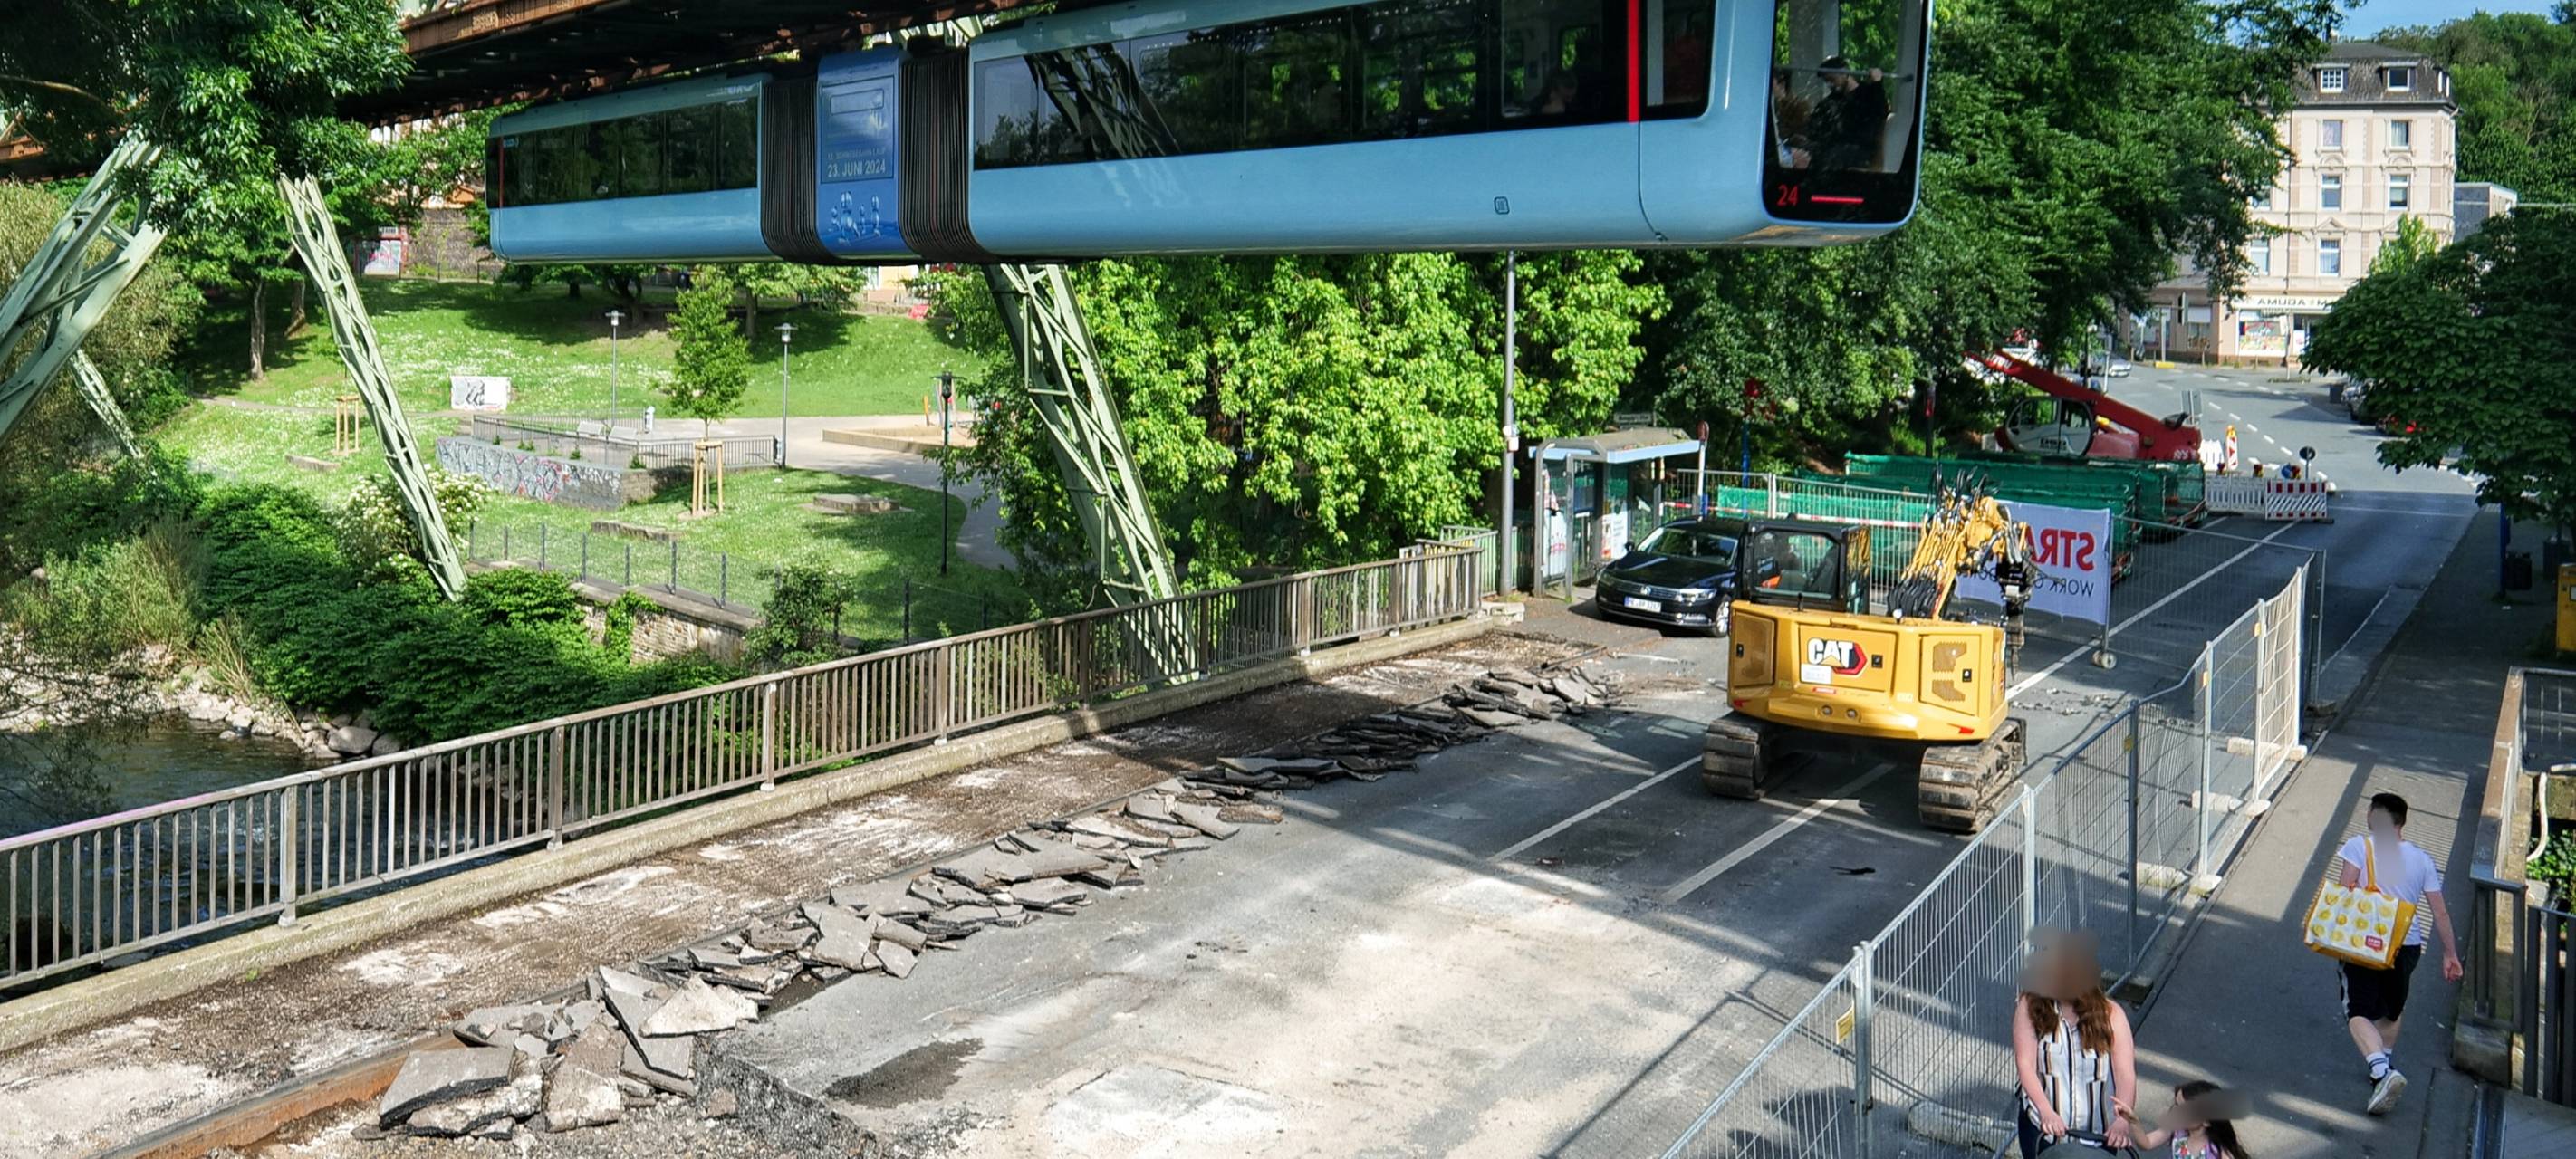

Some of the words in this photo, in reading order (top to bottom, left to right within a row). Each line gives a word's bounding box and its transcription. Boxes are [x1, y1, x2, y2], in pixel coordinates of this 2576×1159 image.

[828, 164, 841, 177] 23.
[842, 161, 863, 176] JUNI
[865, 159, 886, 174] 2024
[1777, 184, 1798, 207] 24
[1807, 637, 1854, 668] CAT
